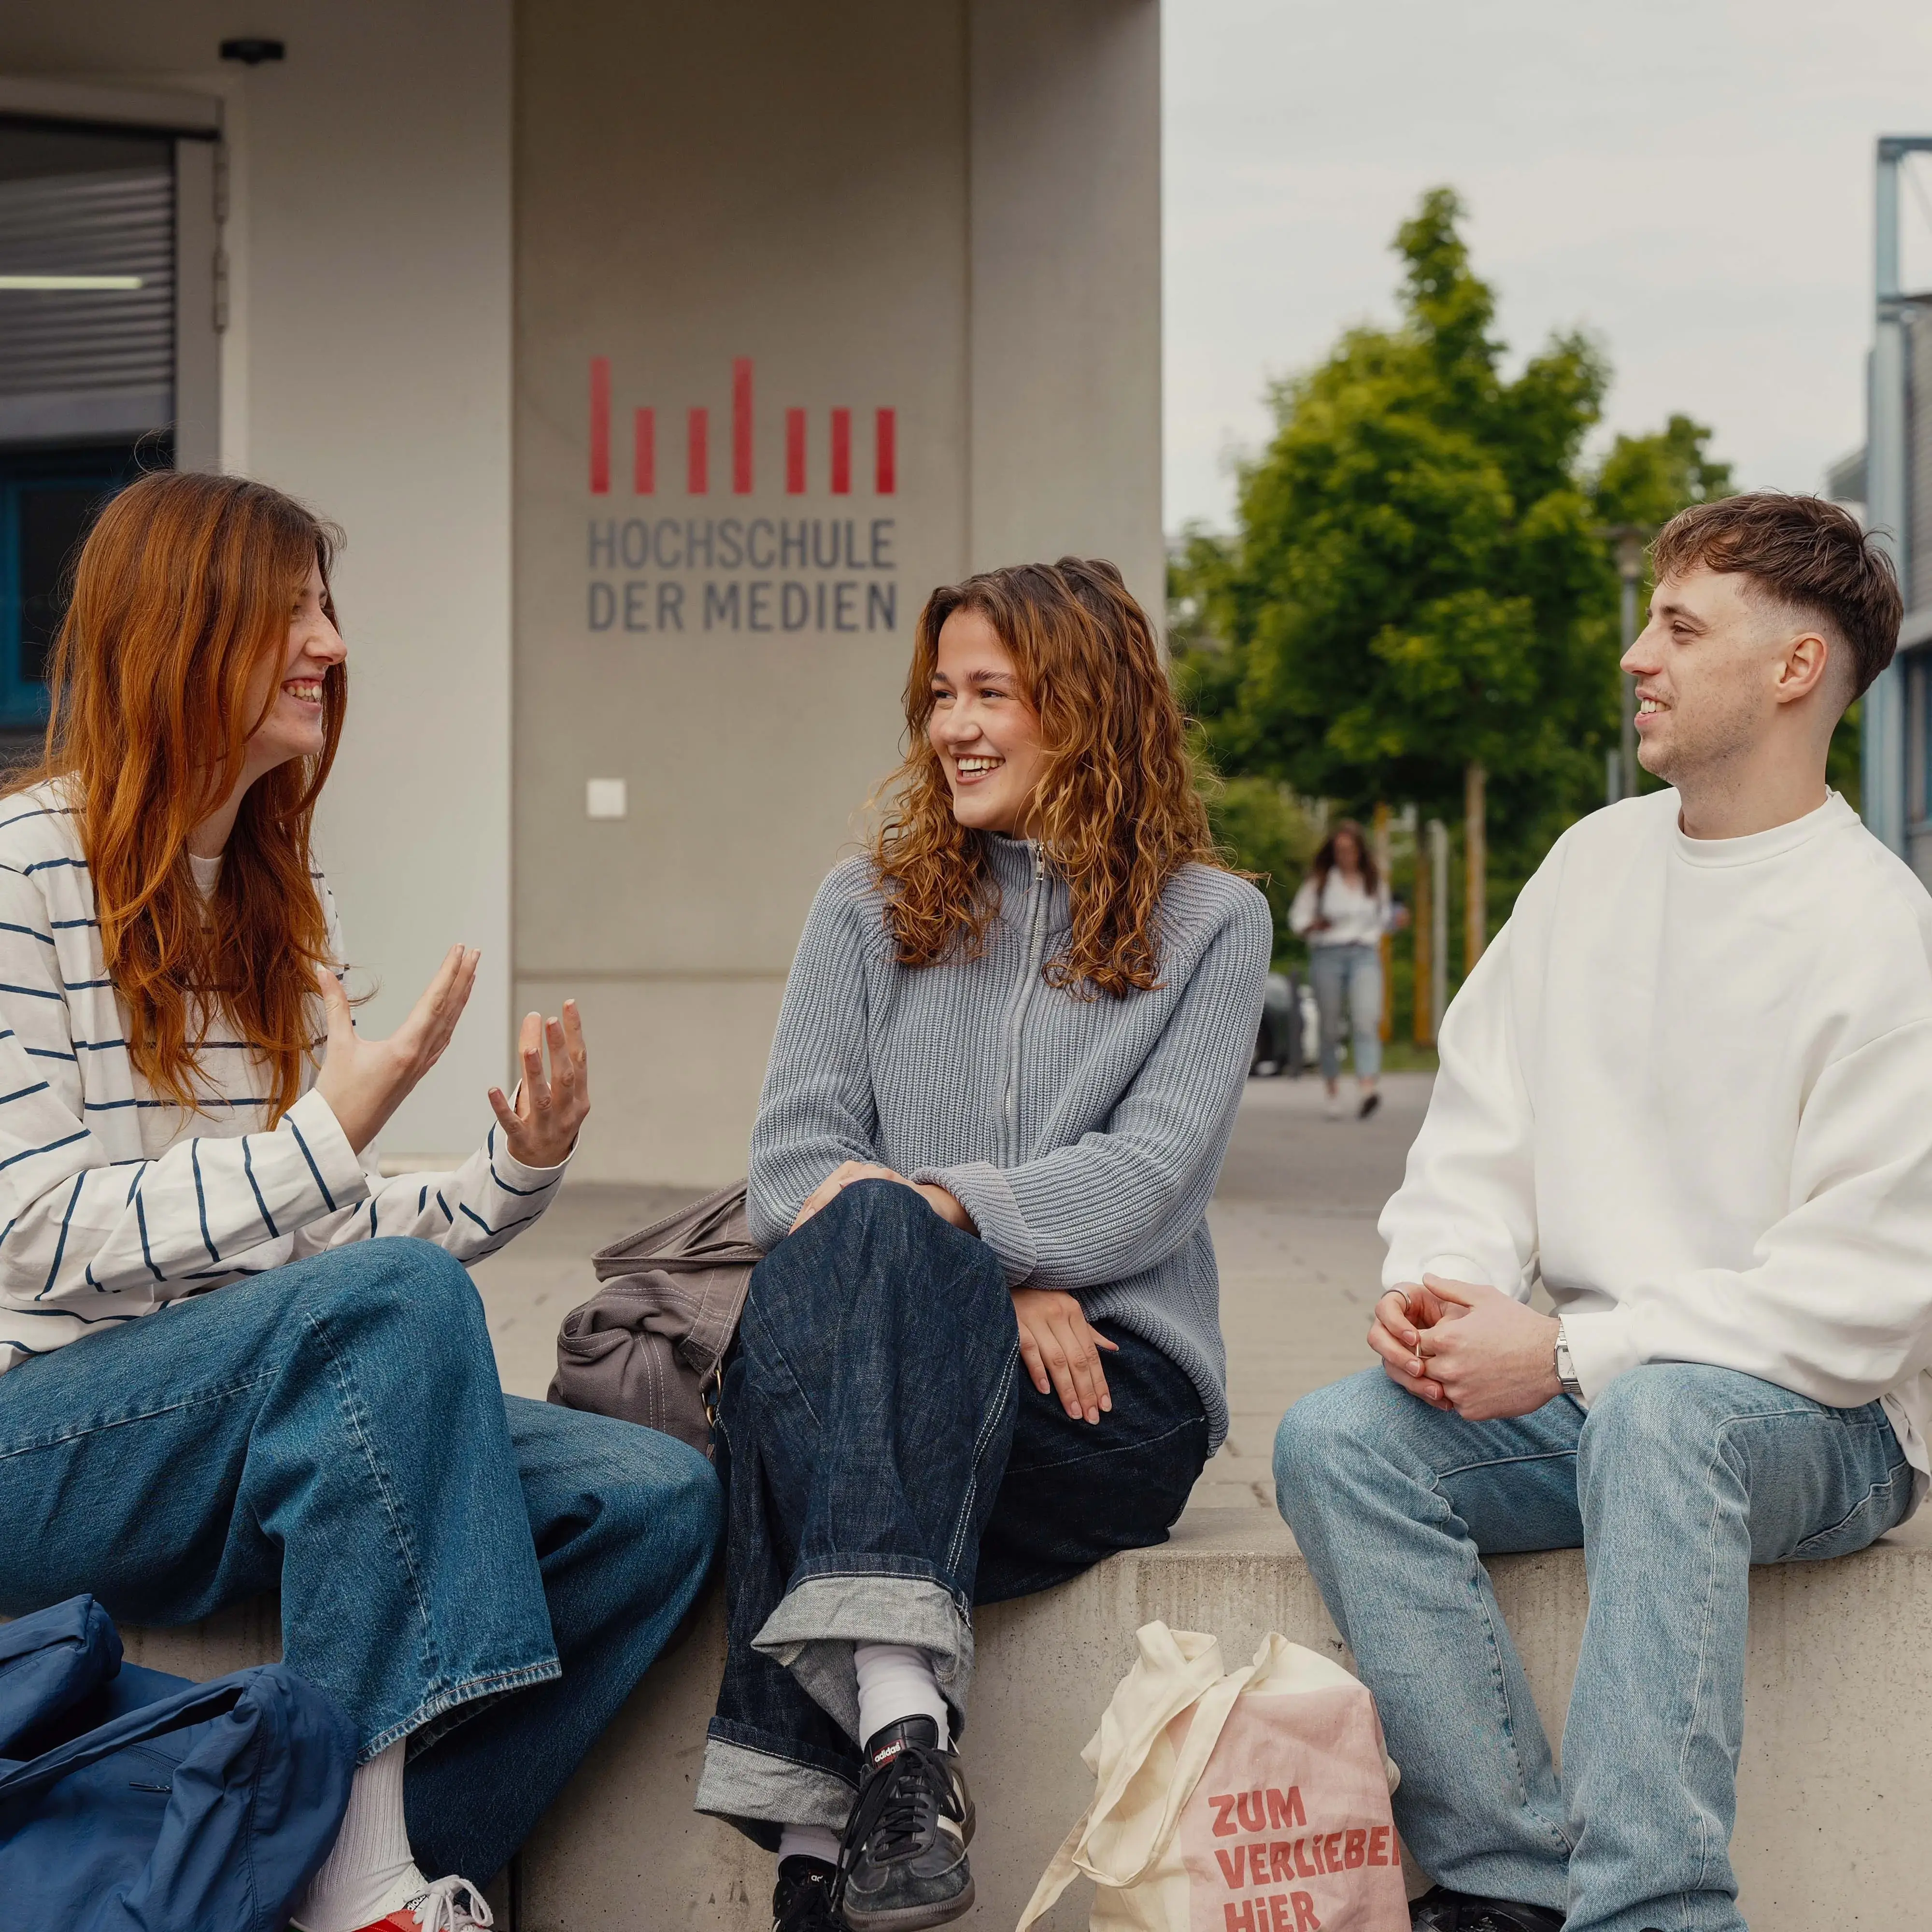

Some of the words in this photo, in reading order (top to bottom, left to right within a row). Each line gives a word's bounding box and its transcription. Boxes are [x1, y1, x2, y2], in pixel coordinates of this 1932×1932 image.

[588, 518, 896, 570] HOCHSCHULE
[588, 581, 685, 632] DER
[703, 581, 897, 632] MEDIEN
[875, 1742, 901, 1762] adidas
[1208, 1786, 1307, 1837] ZUM
